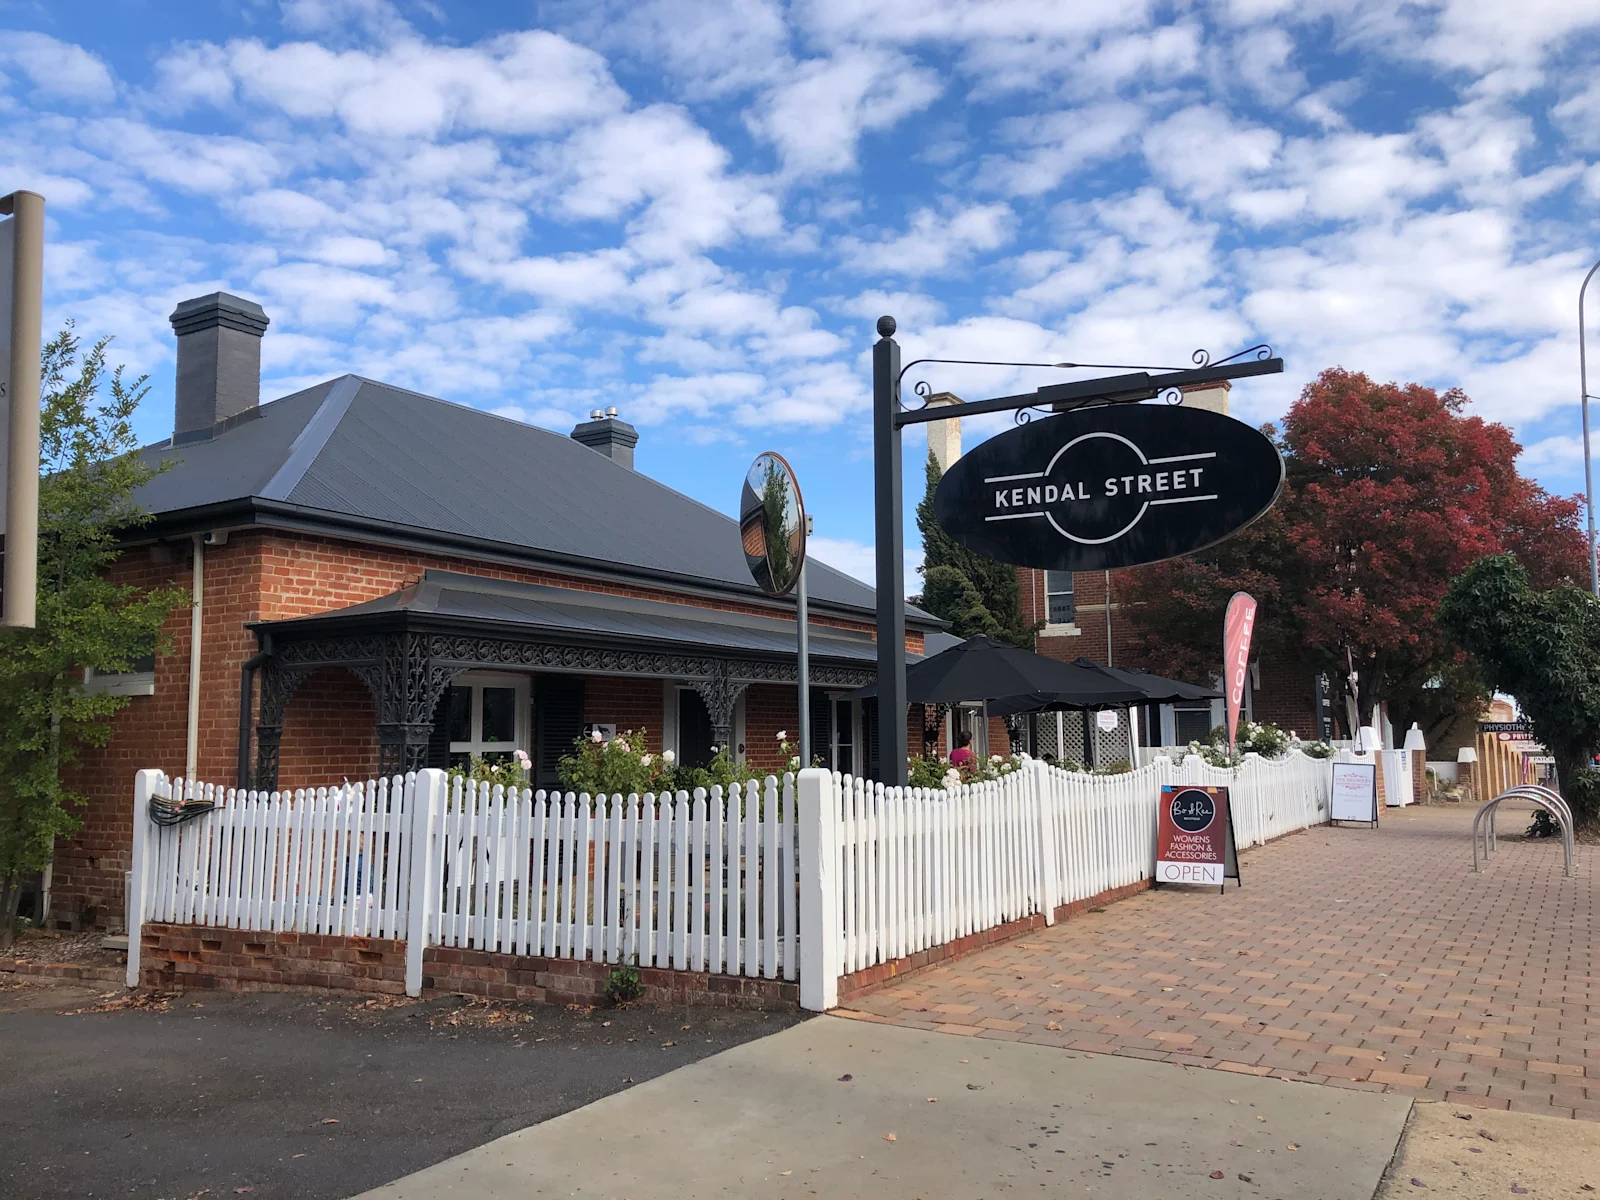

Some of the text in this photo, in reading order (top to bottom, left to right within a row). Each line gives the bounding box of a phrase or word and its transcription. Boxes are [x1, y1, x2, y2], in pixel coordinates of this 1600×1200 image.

[995, 467, 1204, 509] KENDAL STREET
[1173, 801, 1187, 815] Bo
[1173, 835, 1210, 844] WOMENS
[1170, 843, 1205, 851] FASHION
[1165, 851, 1217, 860] ACCESSORIES
[1165, 864, 1216, 882] OPEN
